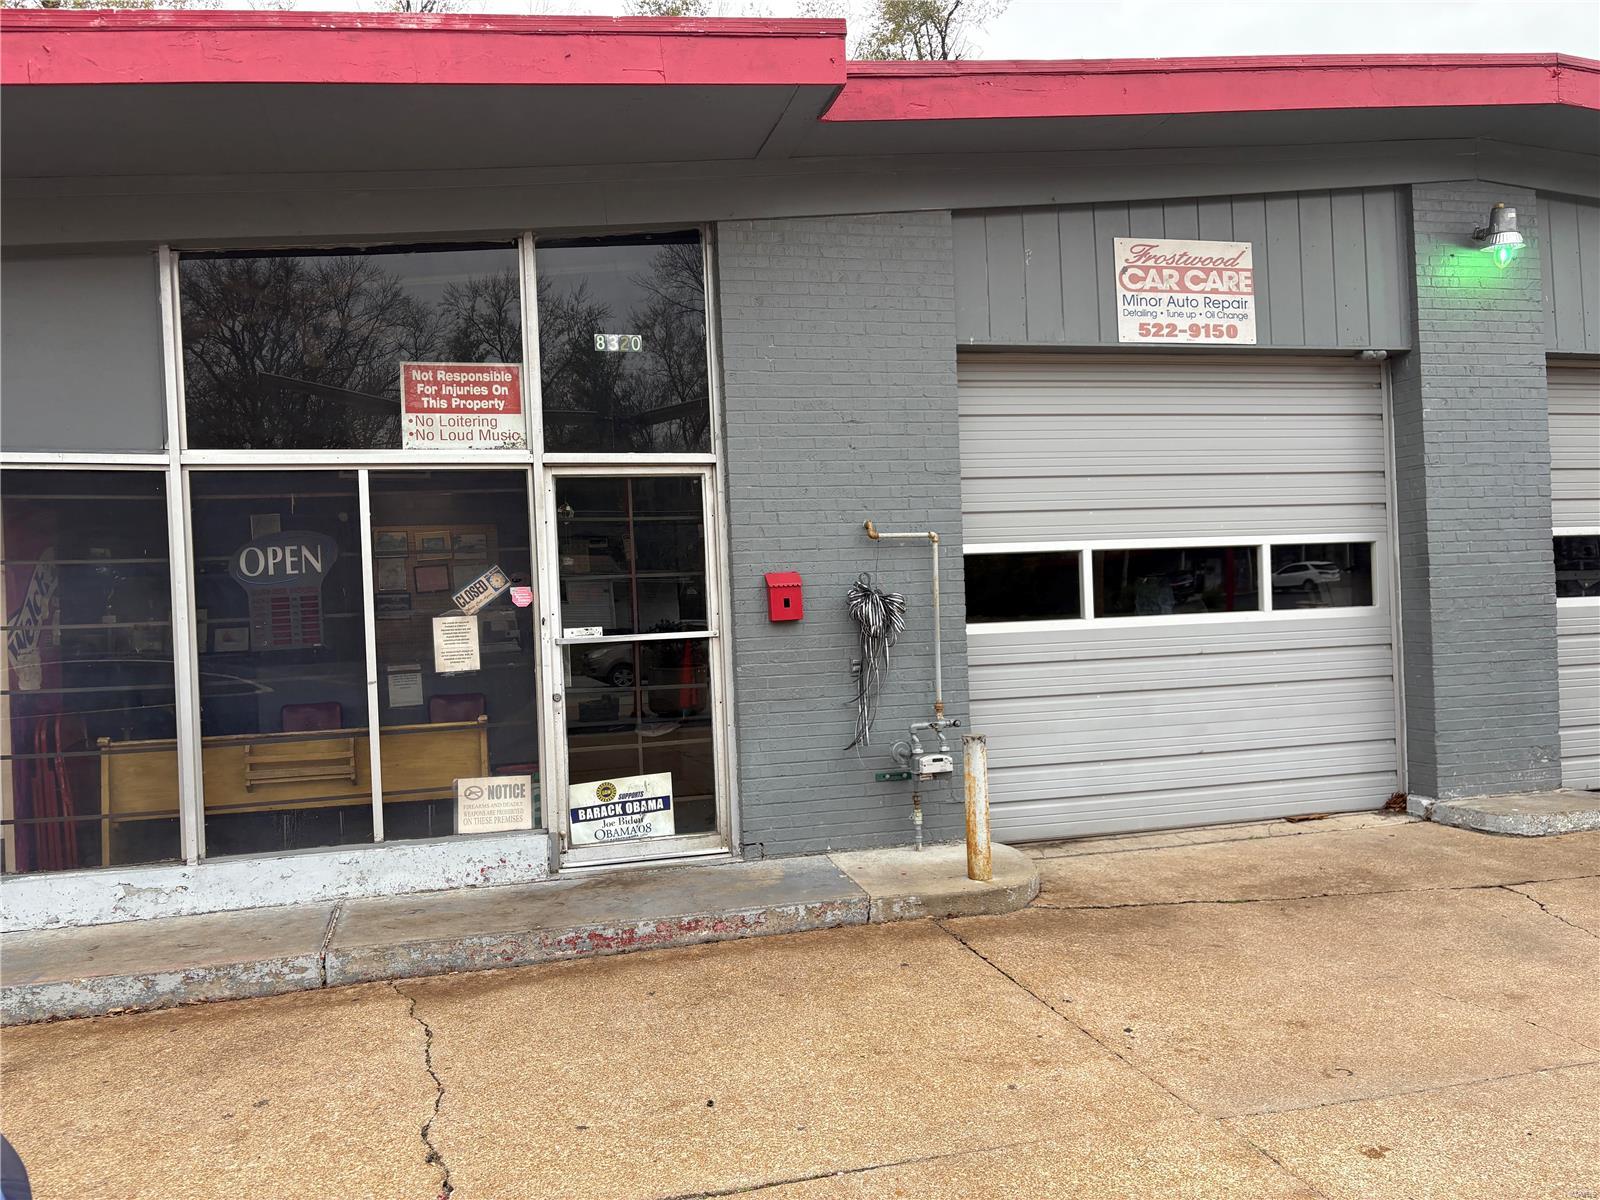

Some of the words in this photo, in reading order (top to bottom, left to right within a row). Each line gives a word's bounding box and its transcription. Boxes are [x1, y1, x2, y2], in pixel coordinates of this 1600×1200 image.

[1125, 244, 1246, 268] Frostwood
[1122, 268, 1180, 291] CAR
[1184, 269, 1252, 293] CARE
[1122, 294, 1162, 308] Minor
[1166, 296, 1198, 308] Auto
[1204, 296, 1248, 311] Repair
[1123, 309, 1158, 319] Detailing
[1166, 310, 1185, 318] Tune
[1186, 312, 1196, 320] up
[1205, 310, 1215, 319] Oil
[1217, 311, 1248, 322] Change
[1138, 323, 1238, 338] 522-9150
[596, 335, 641, 352] 8320
[412, 370, 433, 380] Not
[437, 370, 512, 383] Responsible
[417, 384, 437, 395] For
[442, 384, 488, 396] Injuries
[492, 384, 509, 395] On
[422, 398, 448, 408] This
[452, 398, 505, 411] Property
[415, 415, 434, 427] No
[440, 416, 498, 429] Loitering
[415, 429, 434, 441] No
[440, 429, 473, 441] Loud
[480, 430, 520, 441] Music
[240, 544, 322, 576] OPEN
[456, 580, 488, 608] CLOSED
[488, 784, 526, 800] NOTICE
[618, 791, 644, 800] SUPPORTS
[578, 804, 623, 820] BARACK
[626, 798, 664, 814] OBAMA
[474, 817, 493, 825] THESE
[494, 815, 523, 824] PREMISES
[602, 820, 616, 828] Joe
[594, 823, 652, 840] OBAMA'08
